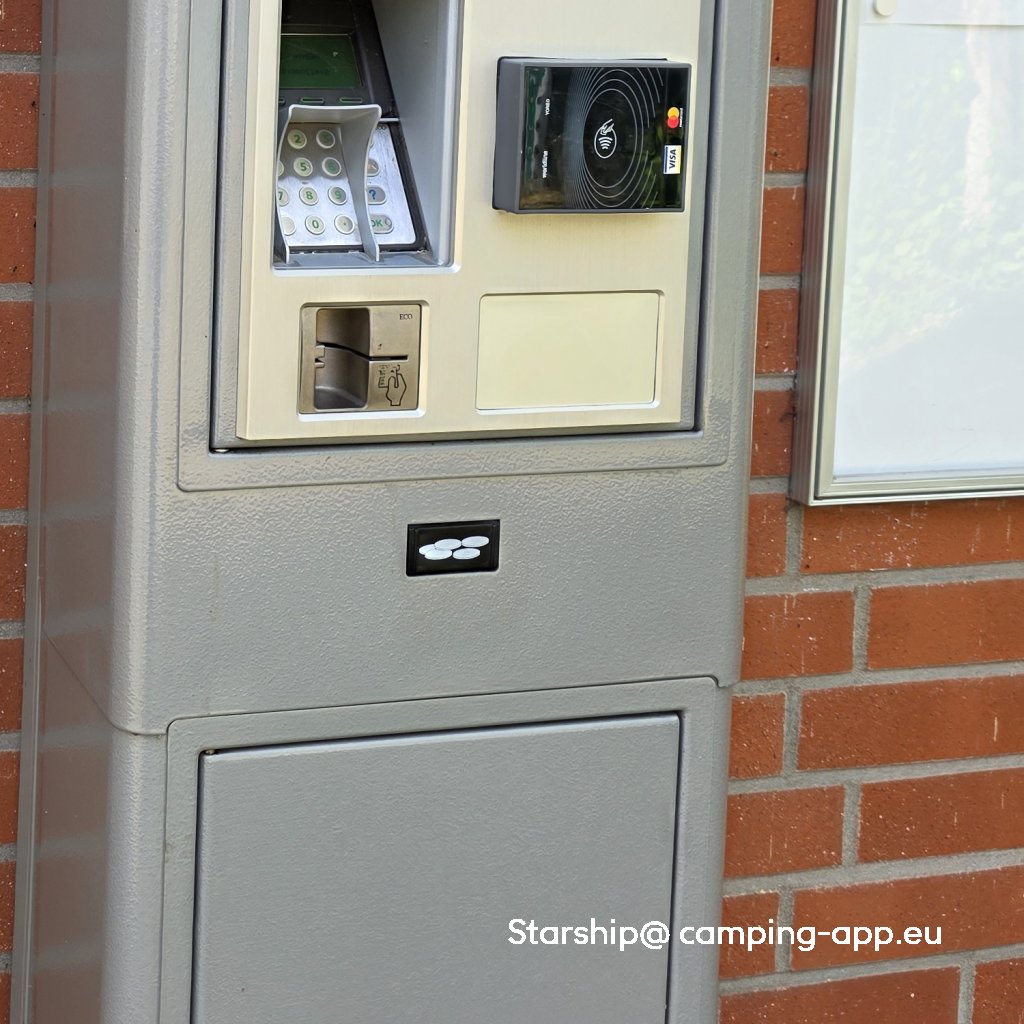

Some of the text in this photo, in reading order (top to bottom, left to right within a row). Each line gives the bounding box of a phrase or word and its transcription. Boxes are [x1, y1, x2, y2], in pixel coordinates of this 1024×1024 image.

[300, 162, 307, 171] 5
[306, 190, 313, 200] 8
[335, 190, 342, 200] 9
[312, 219, 319, 229] 0
